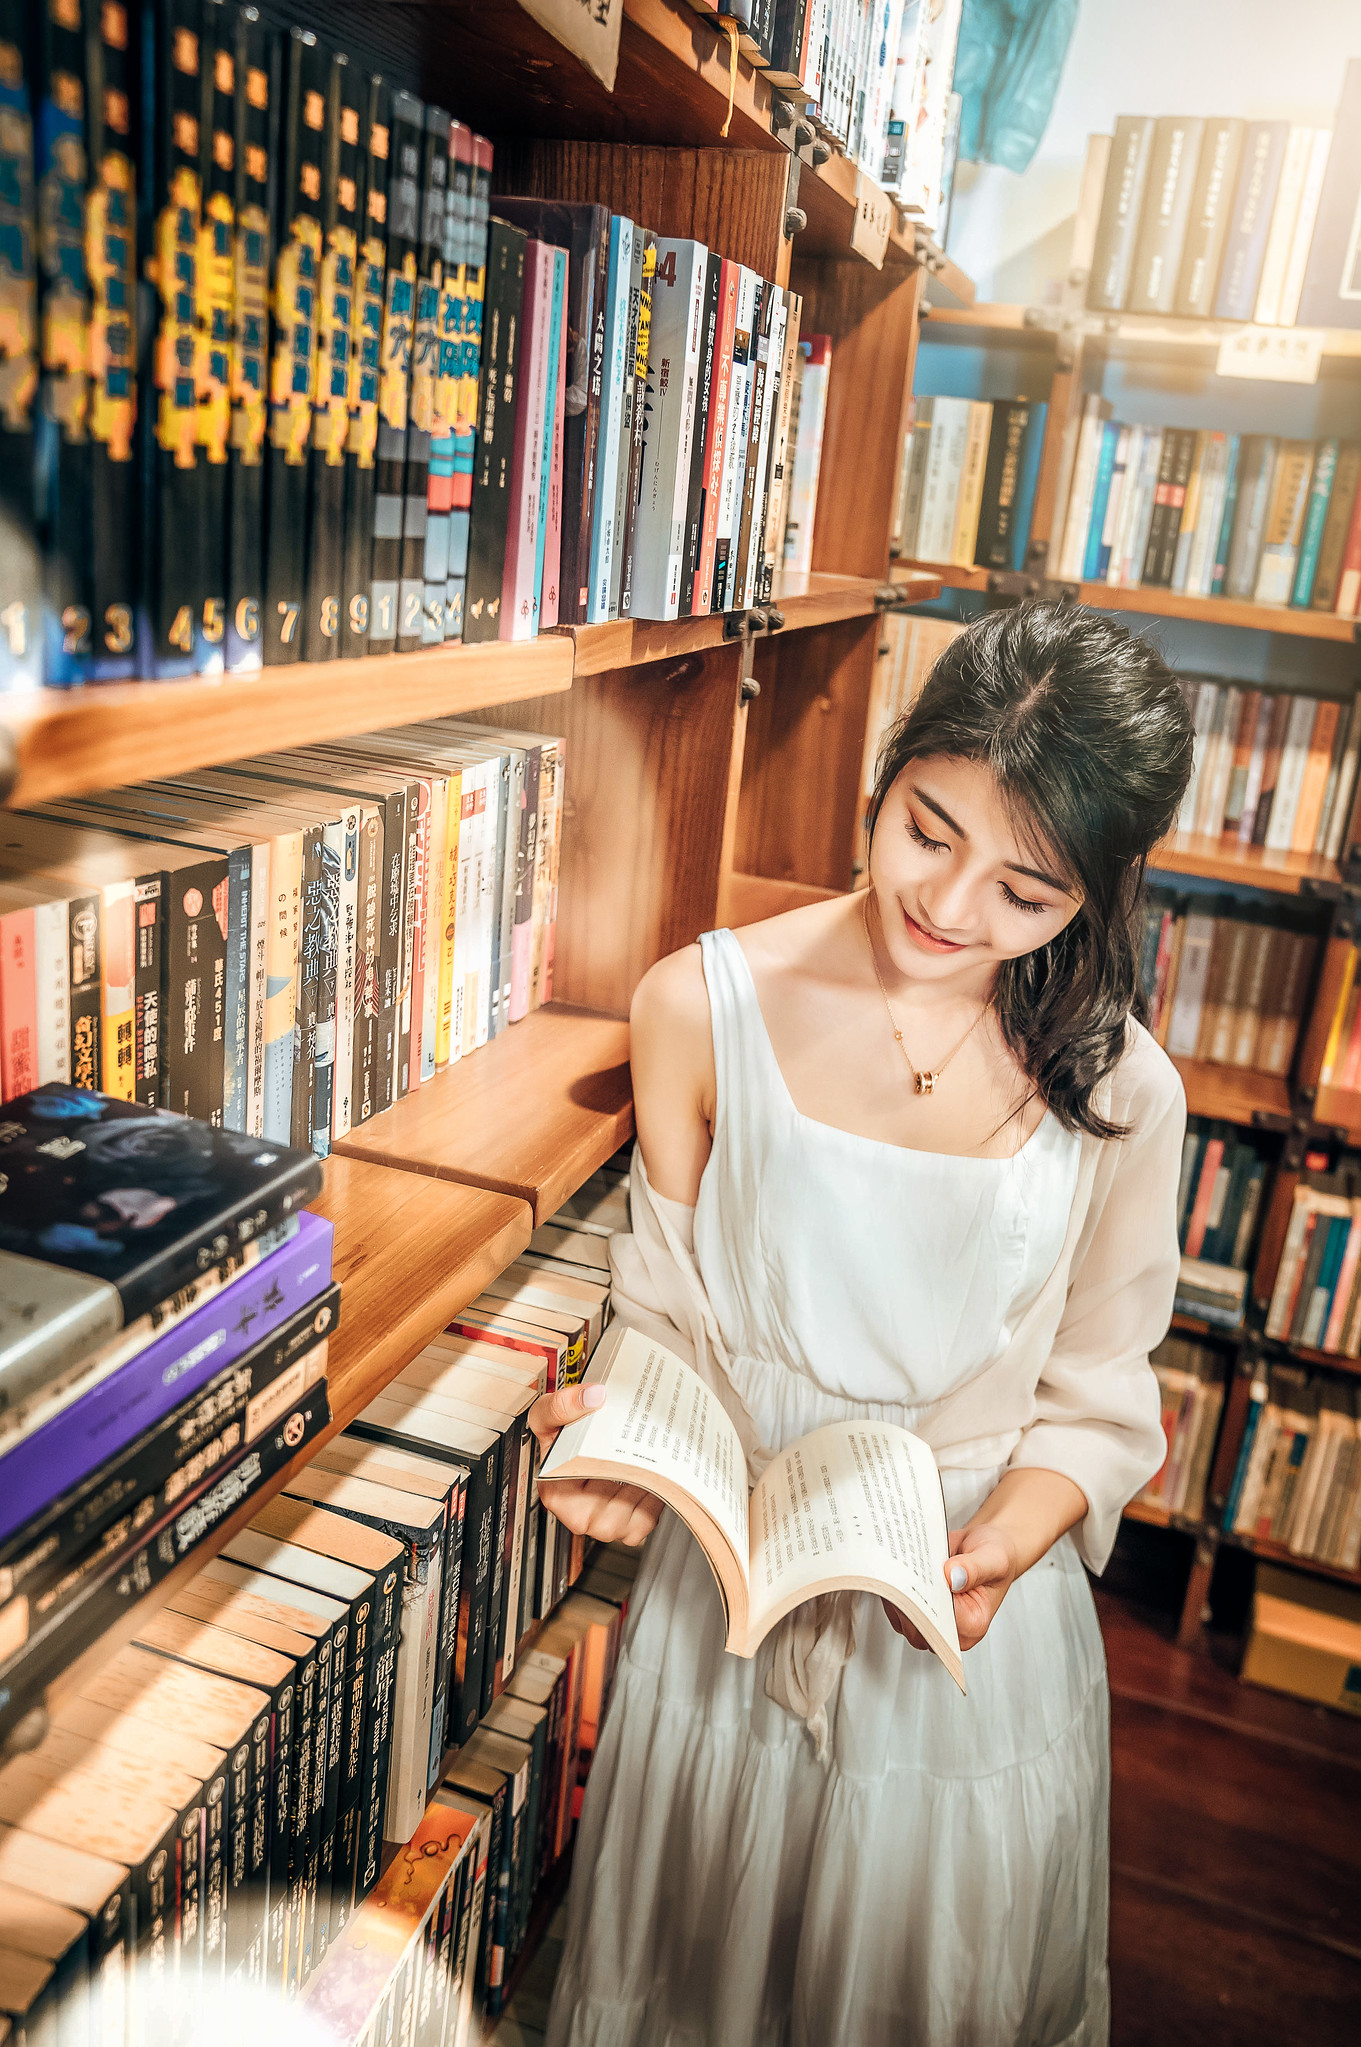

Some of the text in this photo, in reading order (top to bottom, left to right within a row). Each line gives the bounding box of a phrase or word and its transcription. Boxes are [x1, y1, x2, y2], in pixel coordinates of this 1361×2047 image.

[662, 252, 677, 288] 4
[591, 311, 605, 397] 太陽之塔
[711, 352, 731, 498] 不專業偵探社
[652, 461, 660, 511] むげんにんぎょう
[1, 602, 28, 654] 1
[105, 602, 133, 653] 3
[168, 605, 193, 652] 4
[202, 597, 225, 643] 5
[234, 596, 260, 641] 6
[277, 600, 299, 643] 7
[320, 596, 338, 638] 8
[350, 594, 369, 635] 9
[405, 593, 421, 628] 2
[240, 890, 248, 928] INHERIT
[304, 880, 322, 986] 惡之教典
[238, 947, 246, 982] STARS
[213, 958, 224, 1042] 華氏451度
[136, 996, 144, 1081] DEAL BREAKER
[143, 990, 158, 1080] 天使的隱私
[355, 1657, 365, 1672] 02
[371, 1647, 396, 1712] 龍骨
[333, 1683, 343, 1697] 01
